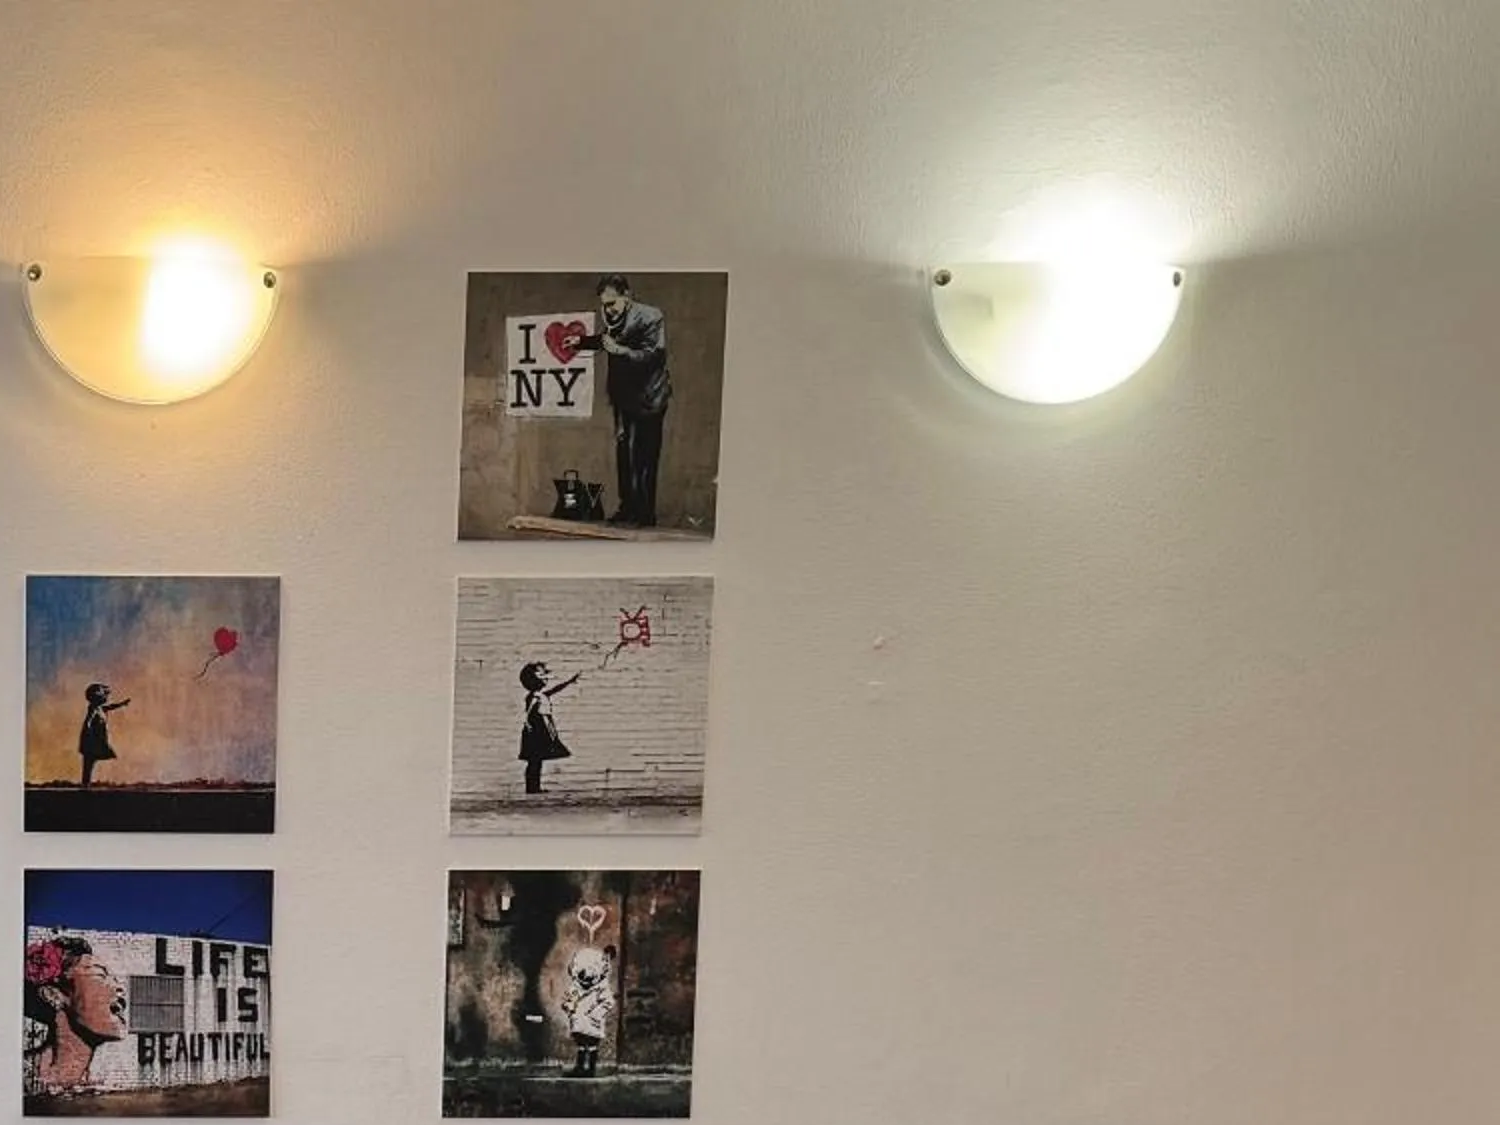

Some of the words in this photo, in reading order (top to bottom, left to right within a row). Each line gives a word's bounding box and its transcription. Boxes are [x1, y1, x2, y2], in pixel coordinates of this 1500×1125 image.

[518, 324, 536, 364] I
[510, 368, 587, 408] NY
[155, 937, 269, 979] LIFE
[216, 988, 258, 1022] IS
[137, 1031, 270, 1066] BEAUTIFUL
